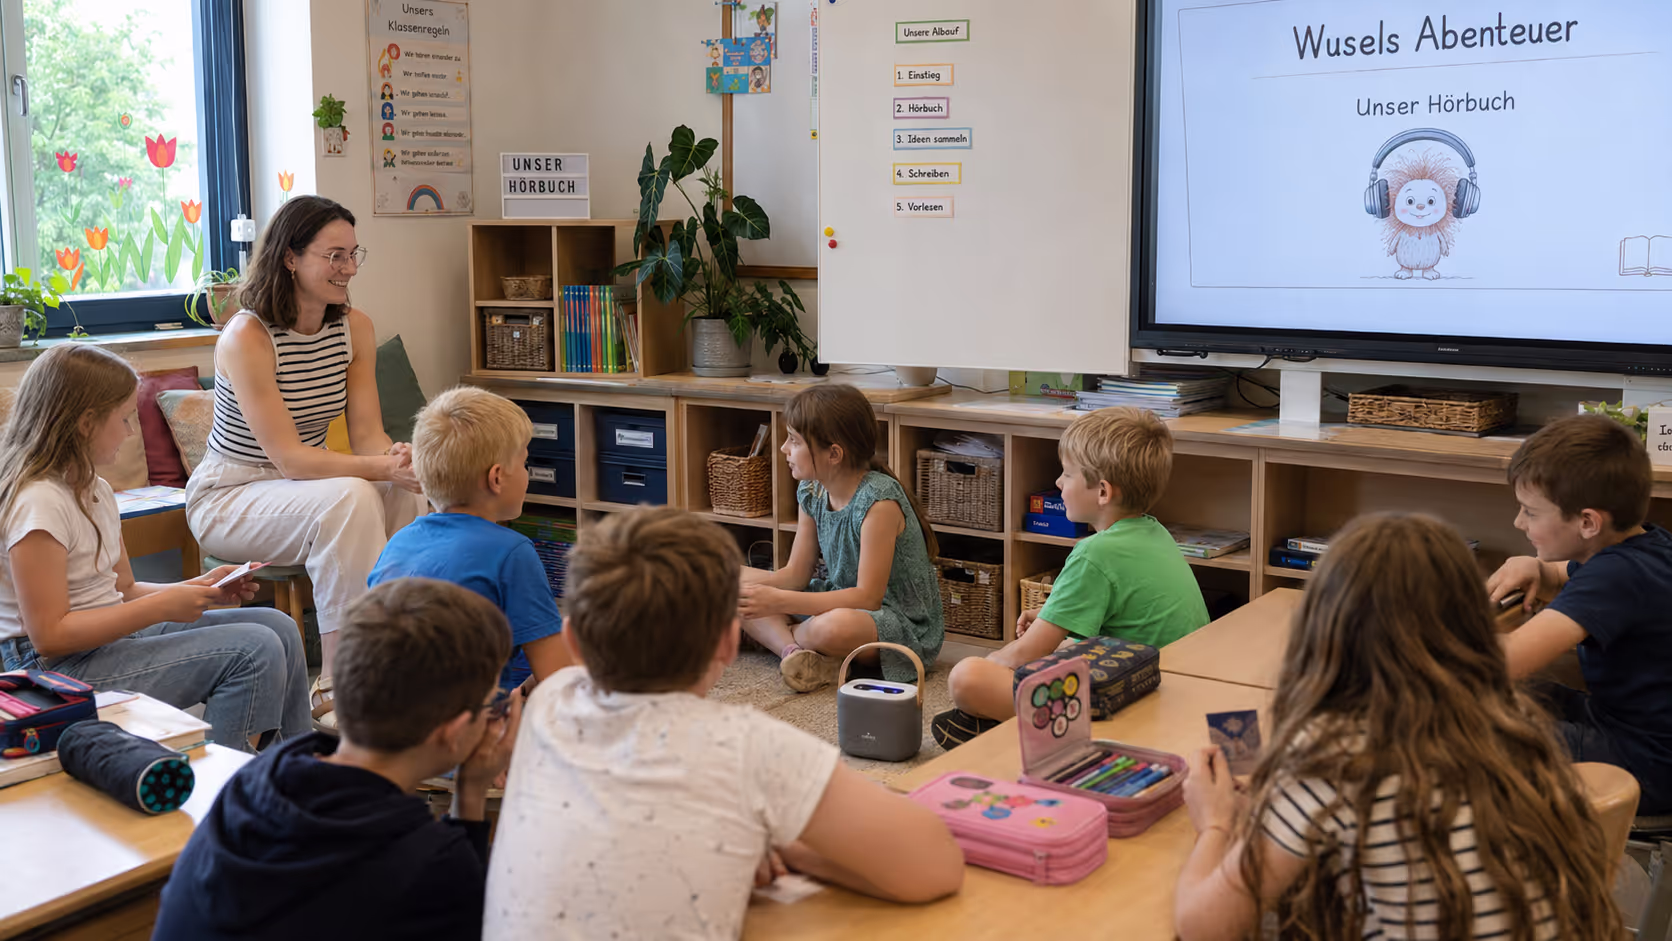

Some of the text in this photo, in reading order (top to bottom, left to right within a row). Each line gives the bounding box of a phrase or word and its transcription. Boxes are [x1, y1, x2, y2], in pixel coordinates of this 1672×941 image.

[402, 3, 434, 16] Unsers
[388, 20, 450, 38] Klassenregeln
[903, 28, 930, 37] Unsere
[1293, 12, 1578, 60] Wusels Abenteuer
[897, 71, 941, 82] 1. Einstieg
[896, 103, 943, 113] 2. Hörbuch
[1356, 90, 1515, 116] Unser Hörbuch
[896, 133, 968, 143] 3. Ideen sammeln
[512, 158, 562, 171] UNSER
[896, 169, 950, 178] 4. Schreiben
[509, 177, 575, 193] HÖRBUCH
[896, 202, 944, 211] 5. Vorlesen
